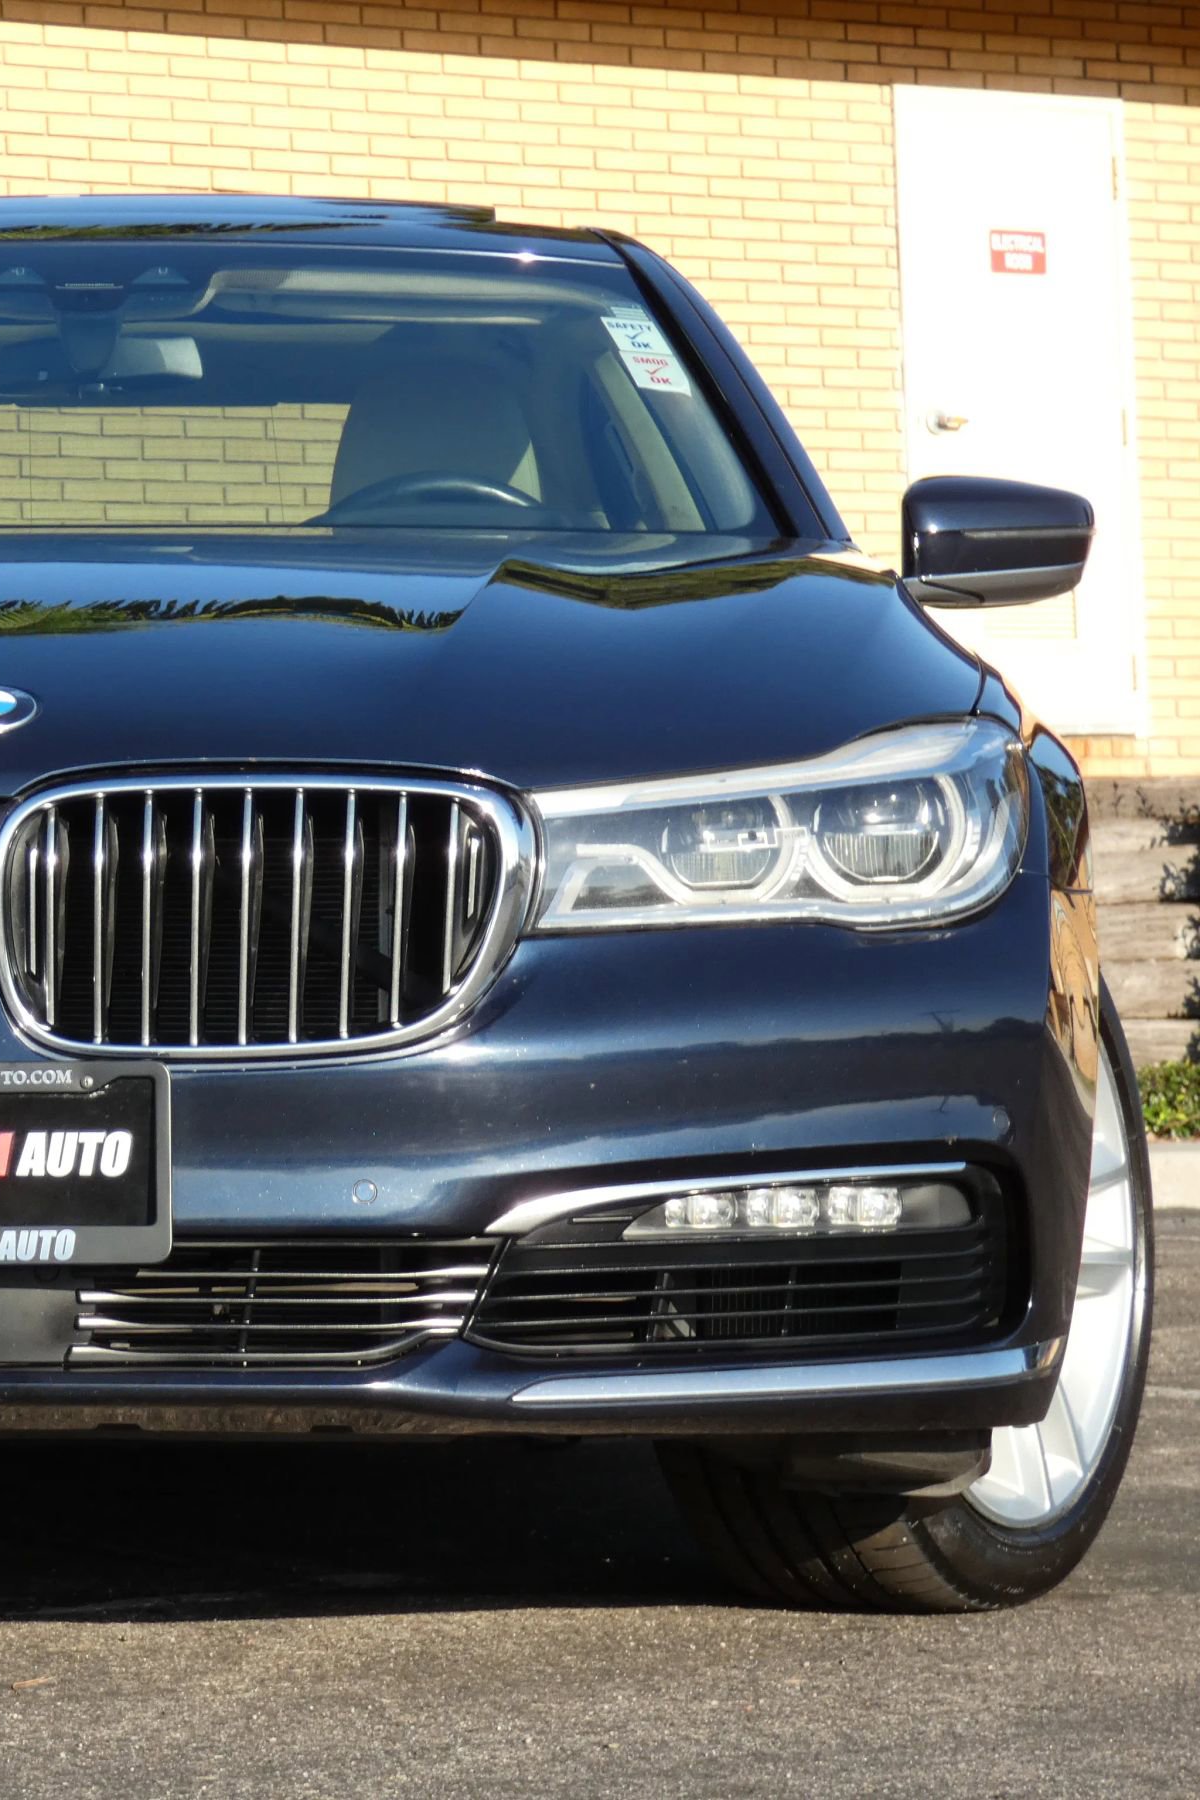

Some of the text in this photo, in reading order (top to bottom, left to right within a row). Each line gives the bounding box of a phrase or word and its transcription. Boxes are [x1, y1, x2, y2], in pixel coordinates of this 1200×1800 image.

[606, 321, 652, 331] SAFETY
[631, 341, 652, 349] OK
[632, 356, 669, 366] SMOG
[650, 376, 672, 385] OK
[15, 1130, 134, 1178] AUTO
